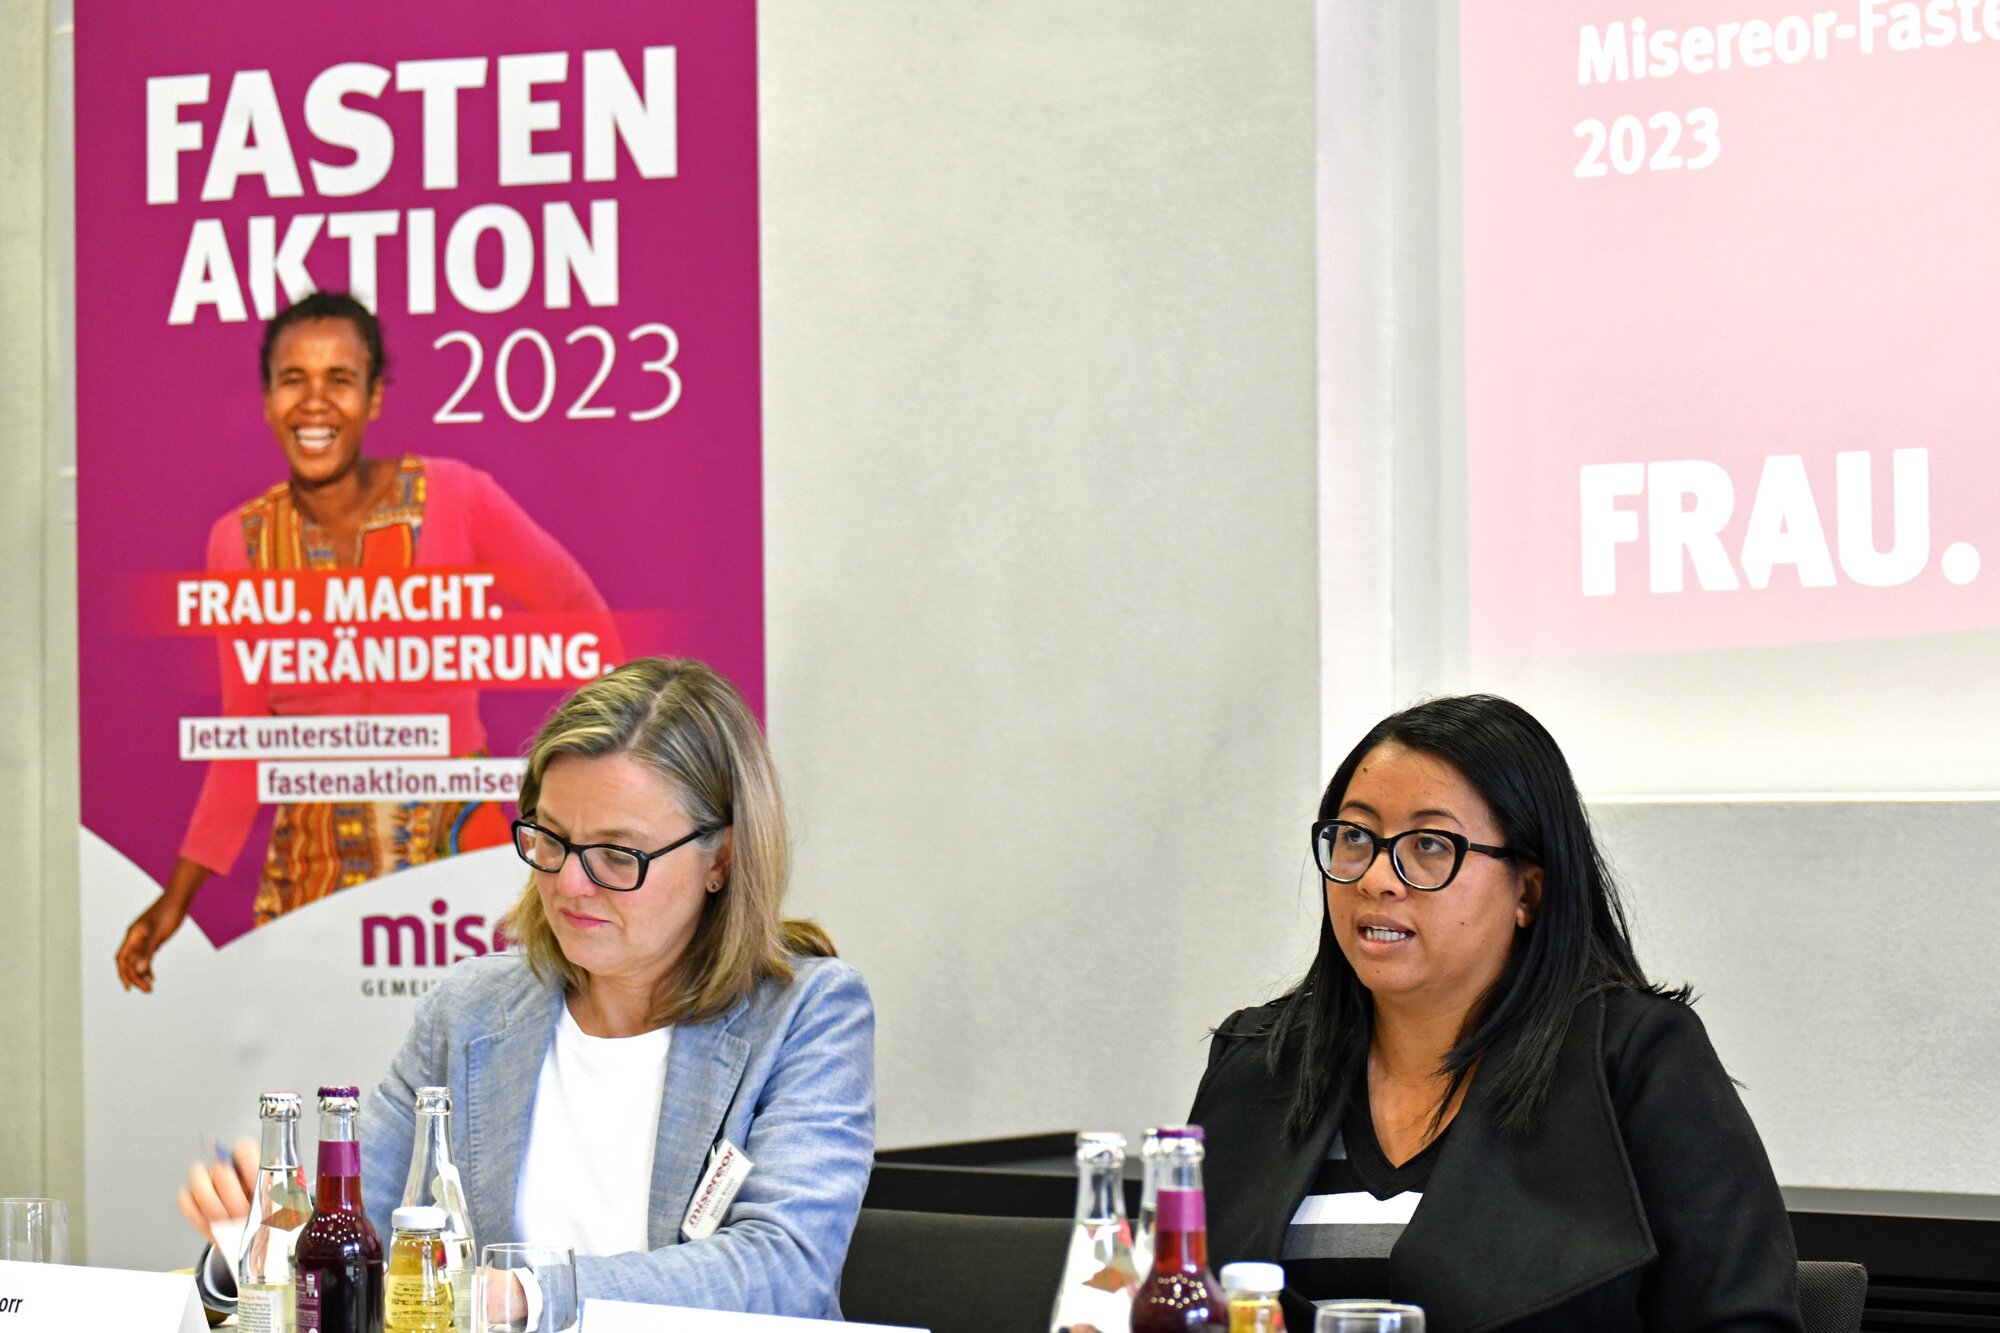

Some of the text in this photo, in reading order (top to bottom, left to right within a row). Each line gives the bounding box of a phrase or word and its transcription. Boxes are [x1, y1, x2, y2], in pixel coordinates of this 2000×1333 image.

[146, 45, 677, 204] FASTEN
[1573, 107, 1721, 178] 2023
[168, 199, 619, 325] AKTION
[433, 323, 683, 424] 2023
[1580, 447, 1981, 597] FRAU.
[177, 573, 504, 626] FRAU. MACHT.
[234, 627, 615, 685] VERÄNDERUNG.
[189, 719, 440, 752] Jetzt unterstützen:
[361, 978, 435, 997] GEMEI
[688, 1146, 735, 1226] misereor
